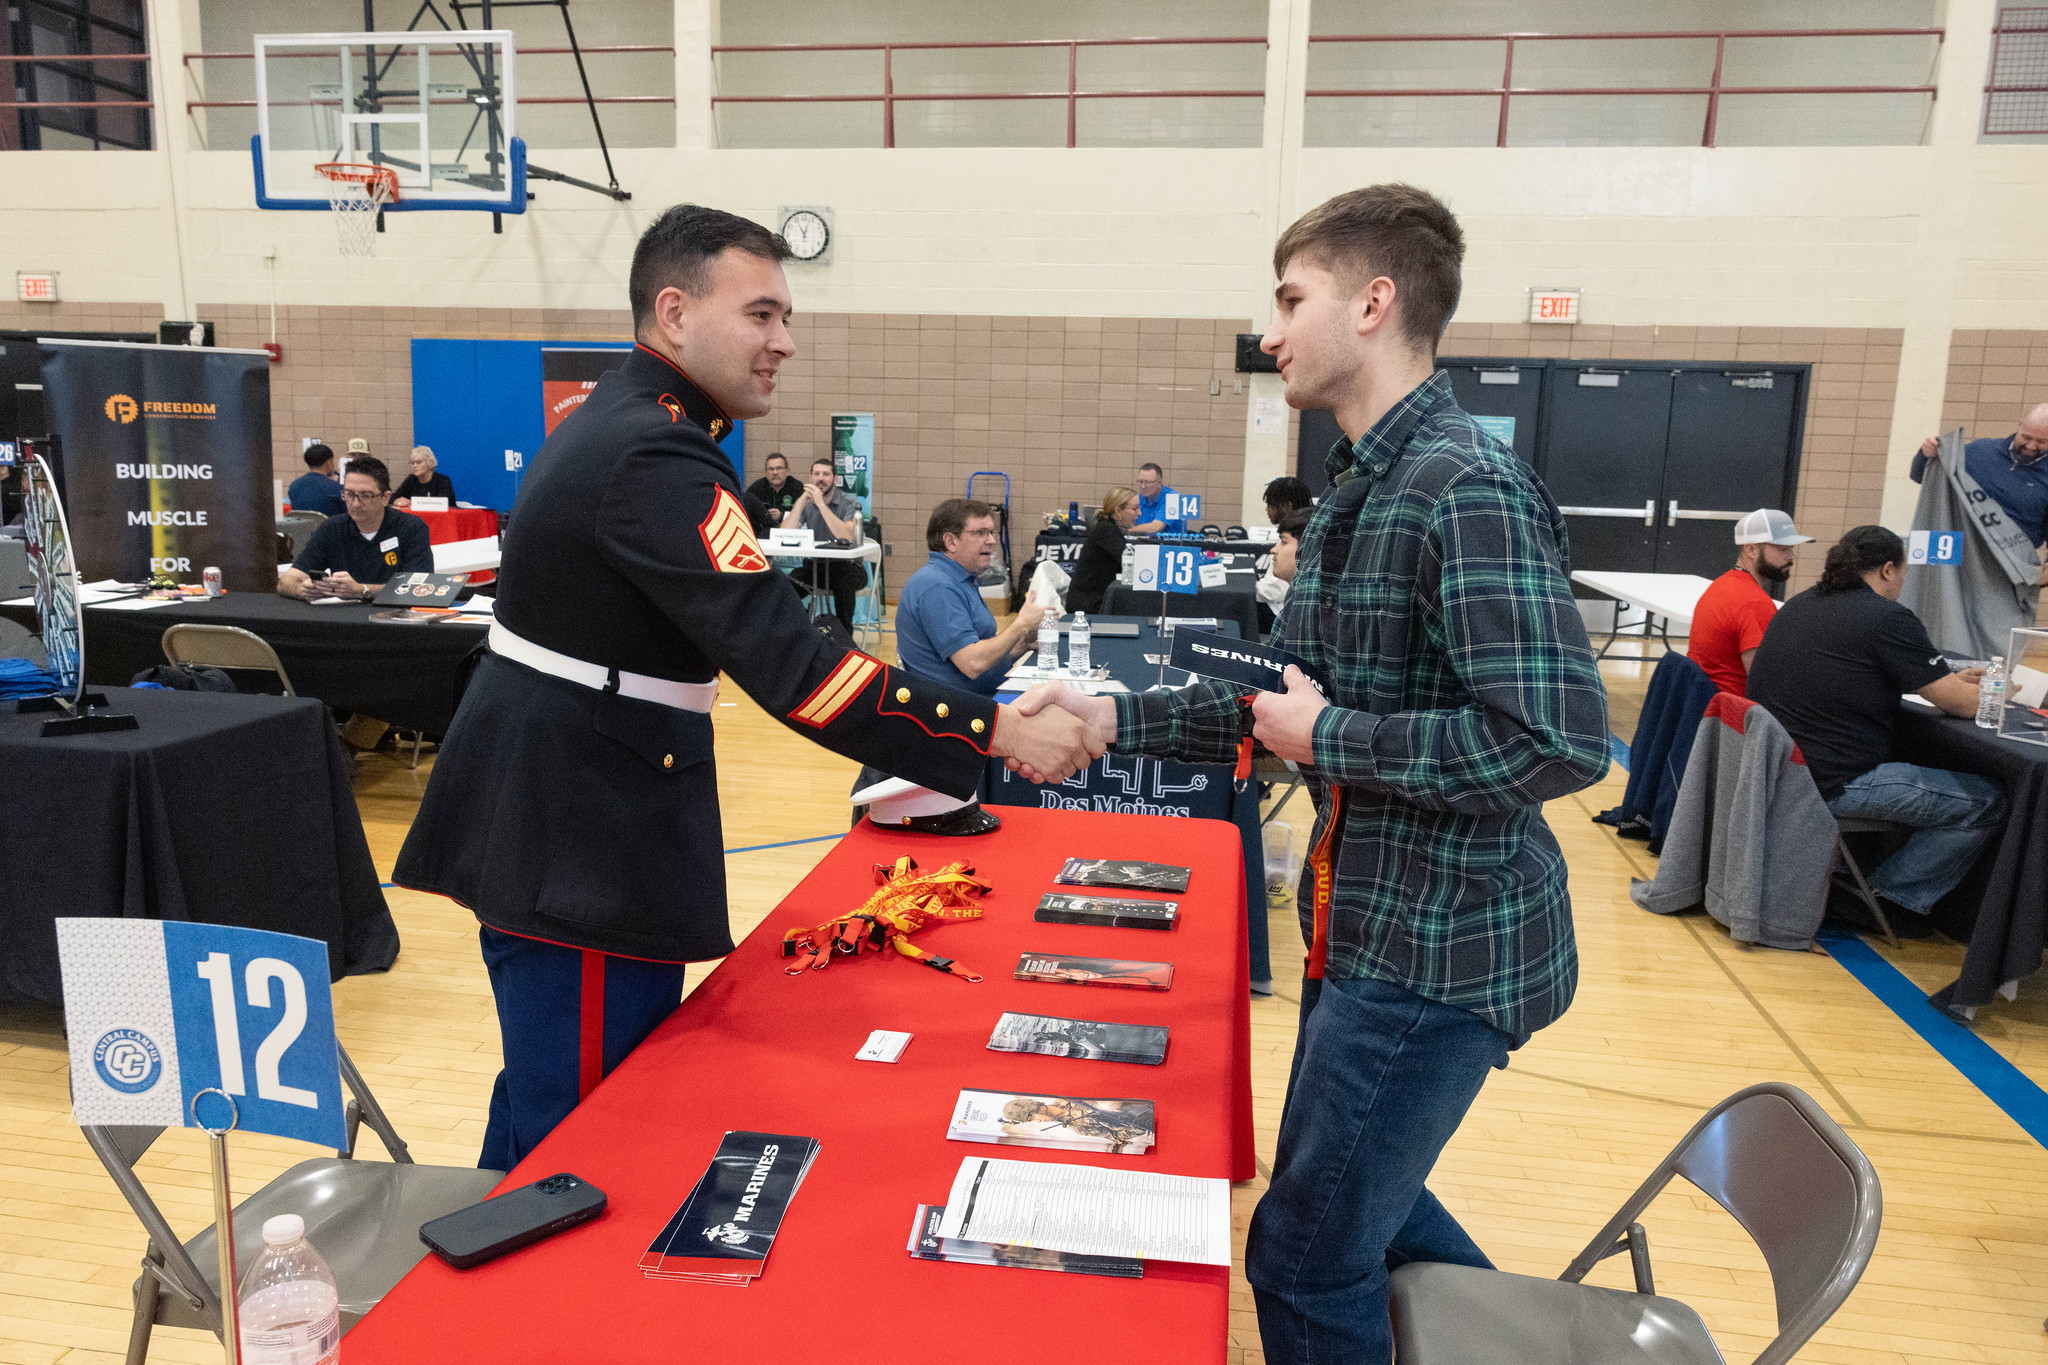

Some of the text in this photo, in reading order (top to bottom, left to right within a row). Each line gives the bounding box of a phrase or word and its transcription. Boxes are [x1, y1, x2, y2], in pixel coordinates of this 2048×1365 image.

[25, 279, 47, 296] EXIT
[1541, 297, 1571, 318] EXIT
[143, 401, 216, 414] FREEDOM
[116, 463, 213, 480] BUILDING
[853, 456, 866, 470] 22
[1181, 496, 1198, 516] 14
[127, 511, 208, 526] MUSCLE
[1937, 535, 1954, 560] 9
[150, 557, 191, 573] FOR
[1165, 551, 1194, 586] 13
[1191, 643, 1324, 695] MRINES
[1039, 789, 1190, 819] Des Moines
[952, 909, 983, 918] THE
[196, 951, 319, 1110] 12
[95, 1030, 160, 1063] CENTRAL CAMPUS
[110, 1043, 147, 1079] CC
[732, 1144, 780, 1223] MARINES
